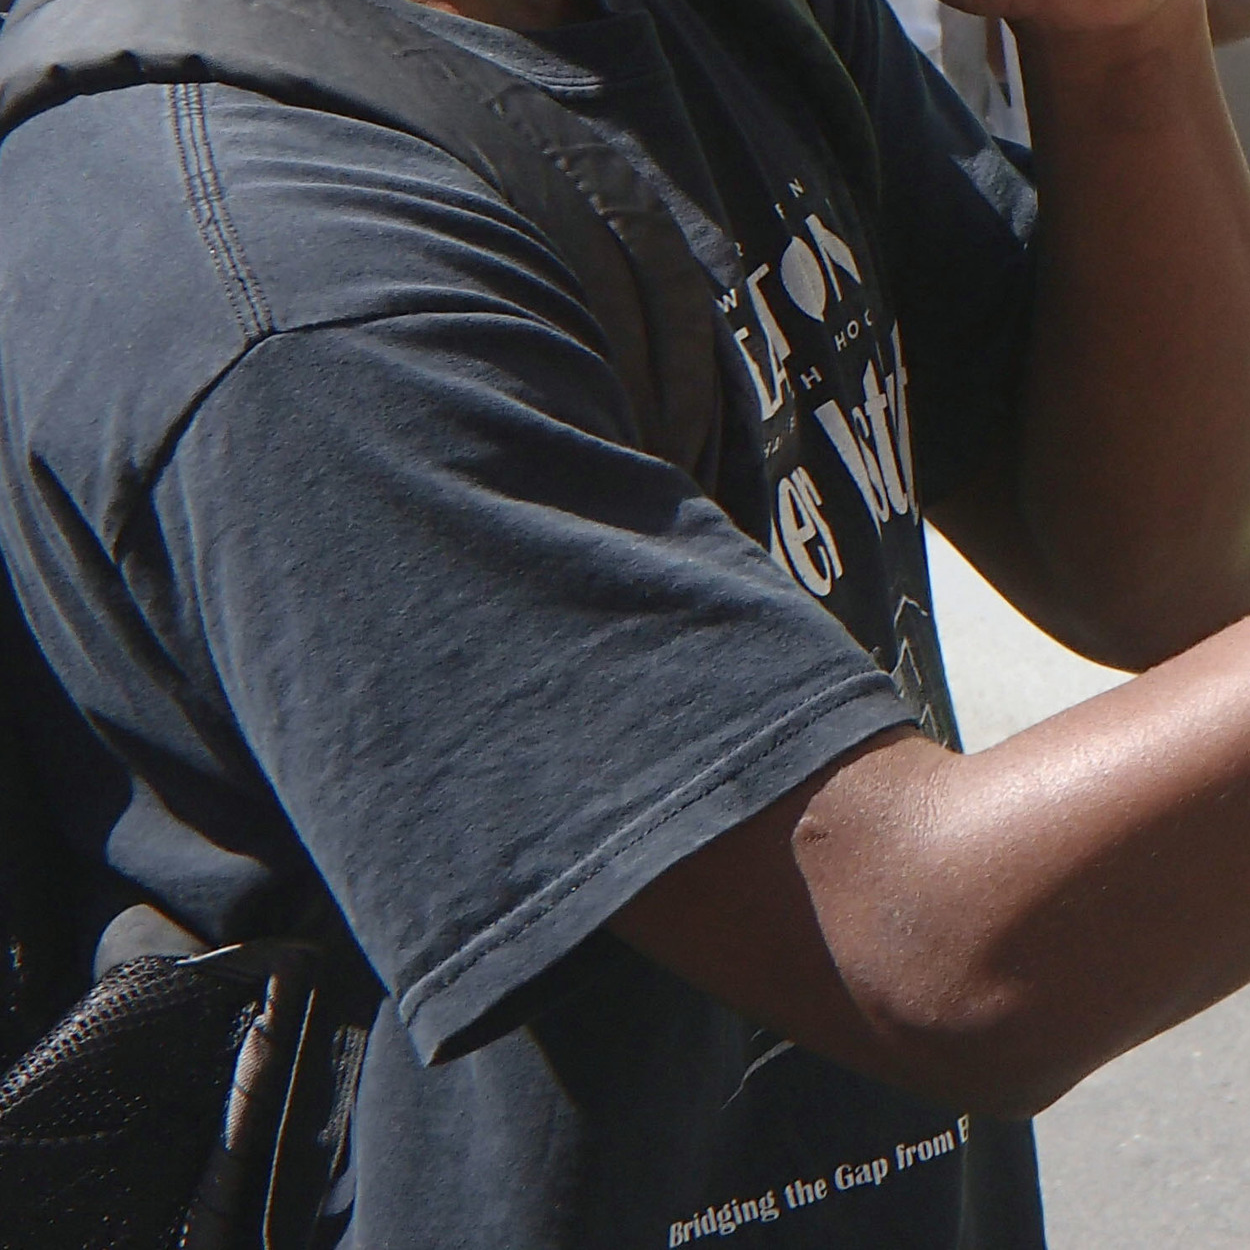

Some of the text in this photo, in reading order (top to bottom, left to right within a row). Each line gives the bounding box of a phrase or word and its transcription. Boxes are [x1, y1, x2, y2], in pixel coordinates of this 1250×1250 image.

[668, 1189, 781, 1249] Bridging
[784, 1176, 829, 1210] the
[834, 1155, 889, 1190] Gap
[894, 1127, 955, 1171] from
